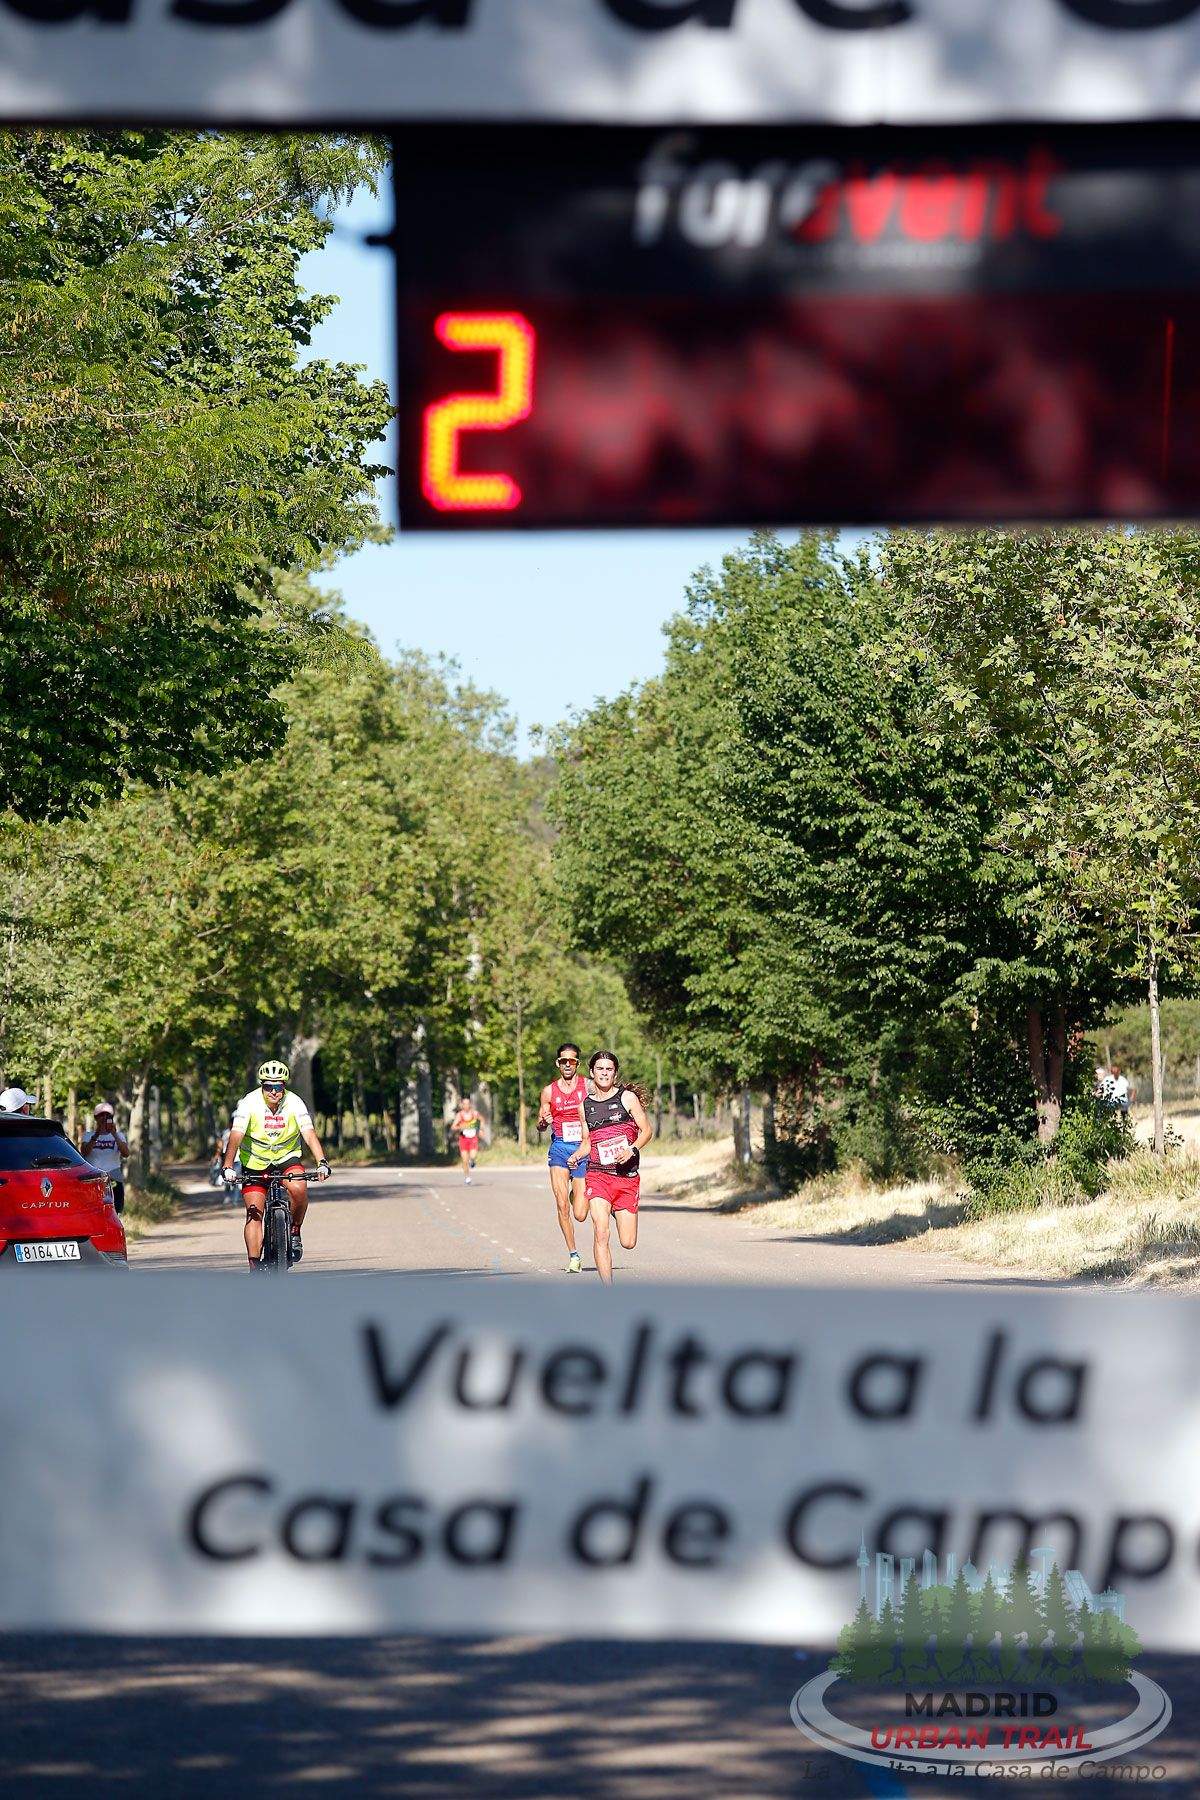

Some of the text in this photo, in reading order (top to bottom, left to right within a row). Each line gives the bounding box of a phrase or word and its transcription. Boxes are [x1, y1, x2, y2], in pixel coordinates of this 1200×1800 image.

[420, 311, 536, 512] 2
[21, 1201, 70, 1209] CAPTUR
[23, 1244, 78, 1260] 8164 LKZ
[360, 1317, 1090, 1428] Vuelta a la
[186, 1473, 1200, 1597] Casa de Camp
